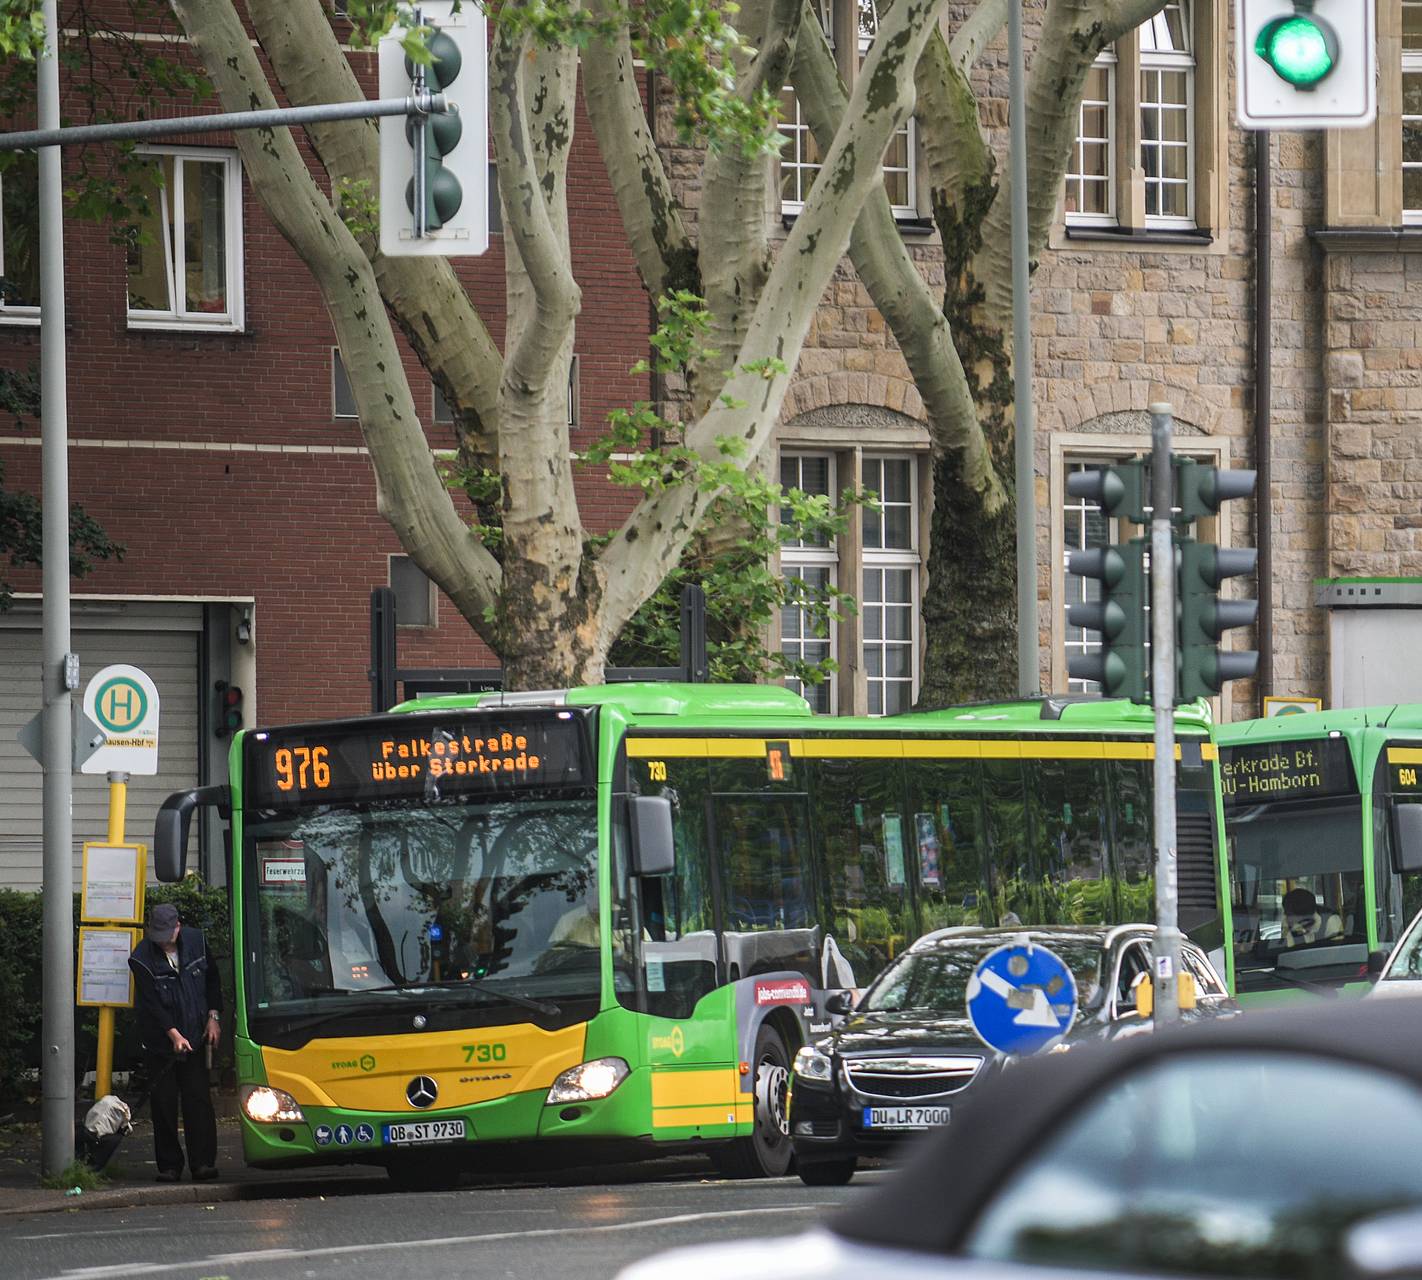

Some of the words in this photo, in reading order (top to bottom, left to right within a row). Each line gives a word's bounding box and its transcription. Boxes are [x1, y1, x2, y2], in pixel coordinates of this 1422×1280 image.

[110, 689, 132, 720] H
[382, 732, 527, 759] Falkestraße
[275, 746, 330, 791] 976
[372, 761, 421, 781] über
[430, 751, 540, 778] Sterkrade
[648, 761, 667, 781] 730
[1220, 753, 1289, 775] erkrade
[1295, 749, 1318, 768] Bf.
[1399, 768, 1417, 785] 604
[462, 1043, 506, 1063] 730
[872, 1109, 888, 1123] DU
[896, 1109, 913, 1123] LR
[915, 1109, 949, 1123] 7000
[390, 1126, 406, 1141] OB
[414, 1124, 430, 1139] ST
[433, 1122, 463, 1137] 9730
